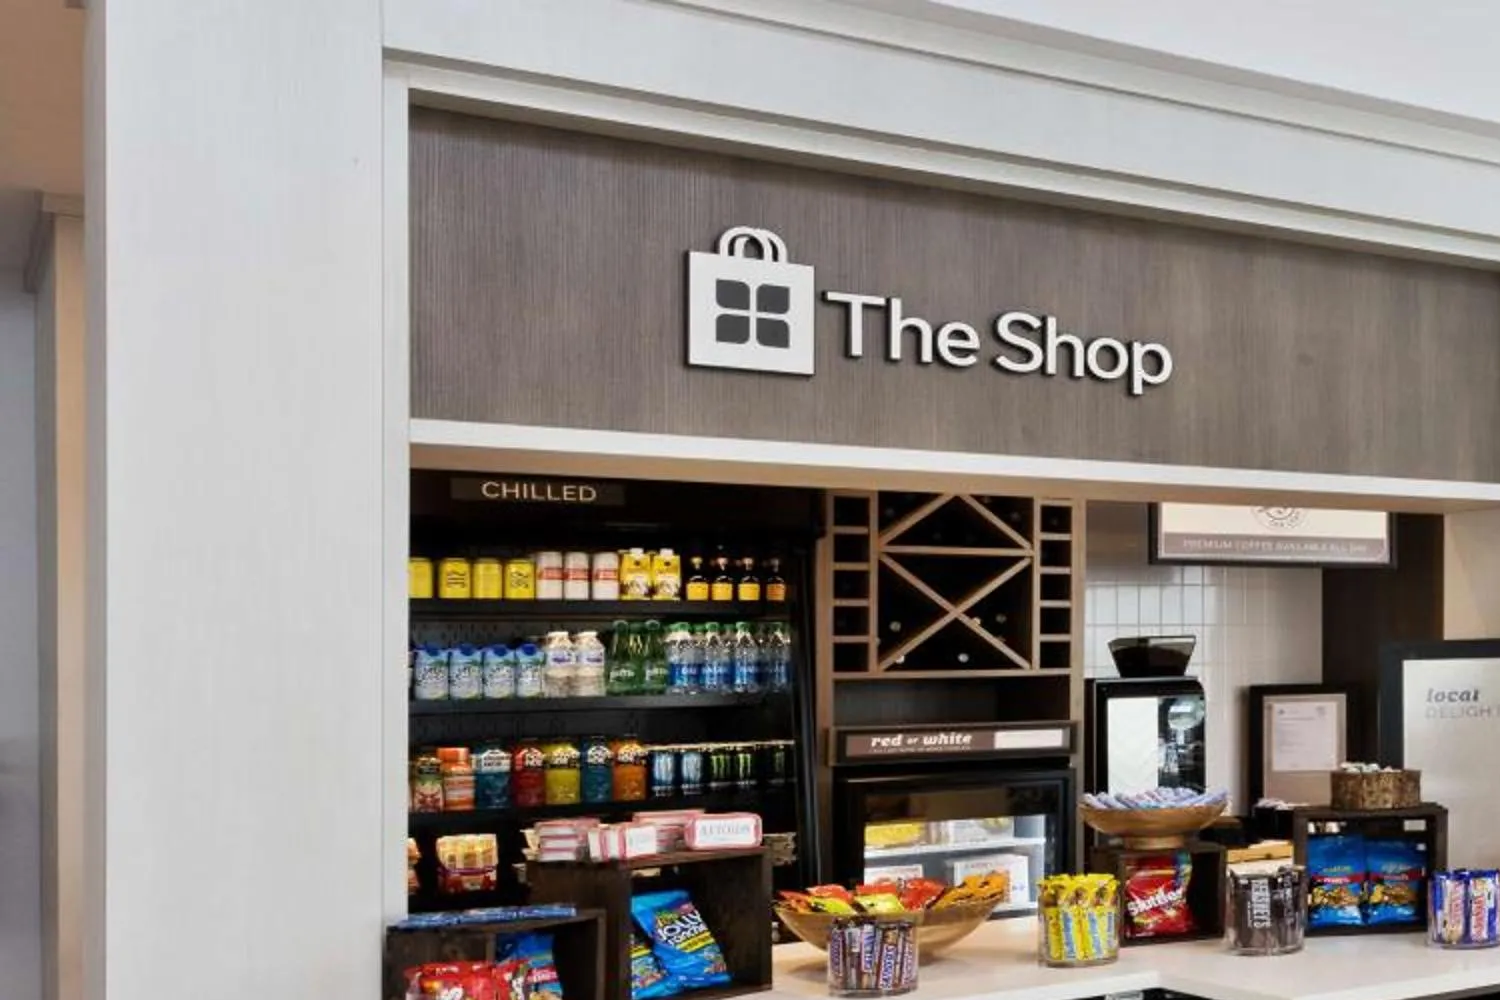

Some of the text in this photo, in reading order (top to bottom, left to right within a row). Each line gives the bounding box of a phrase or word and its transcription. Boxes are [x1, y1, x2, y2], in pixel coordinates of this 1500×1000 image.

[826, 291, 1173, 396] The Shop
[481, 481, 597, 501] CHILLED
[1425, 688, 1479, 702] local
[871, 733, 902, 747] red
[923, 731, 972, 745] white
